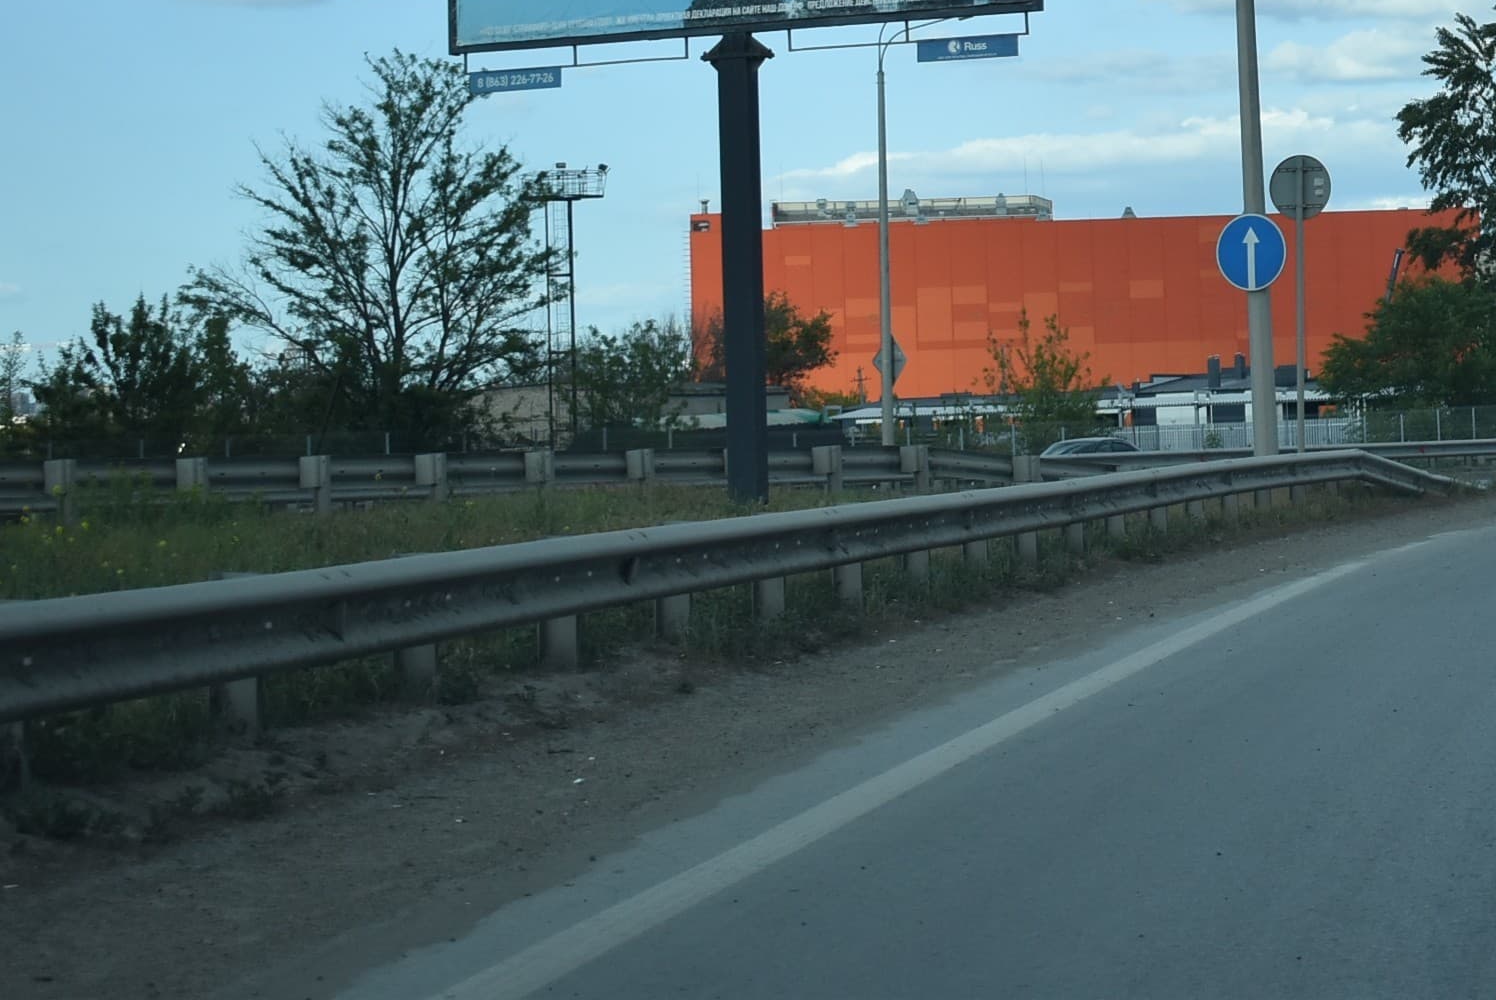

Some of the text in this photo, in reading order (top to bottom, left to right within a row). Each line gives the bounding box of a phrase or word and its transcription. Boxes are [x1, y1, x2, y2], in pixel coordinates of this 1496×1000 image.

[963, 41, 988, 51] Russ
[477, 77, 484, 88] 8
[485, 75, 508, 88] (863)
